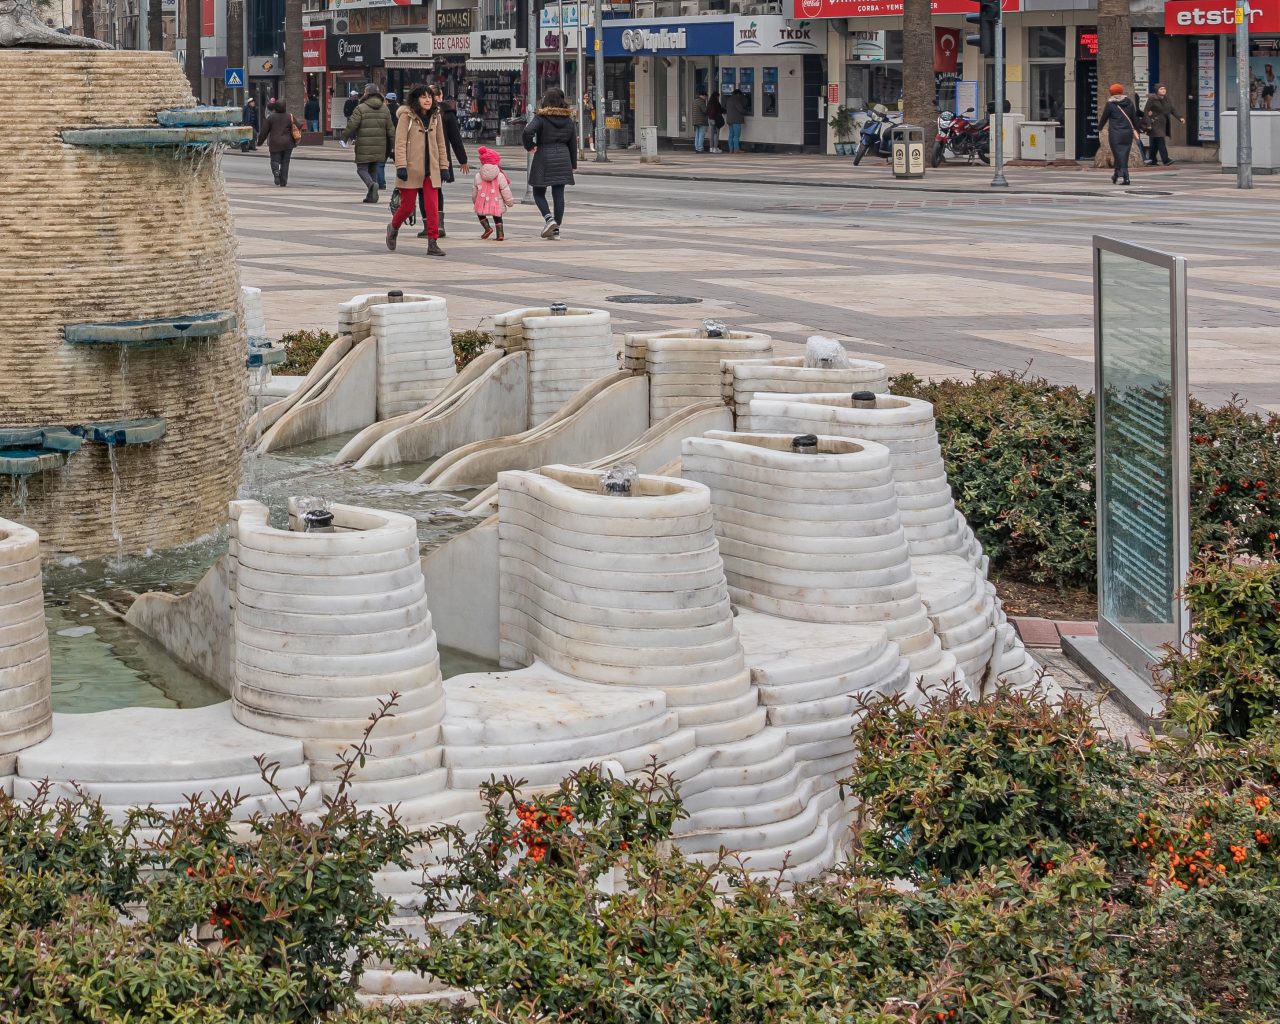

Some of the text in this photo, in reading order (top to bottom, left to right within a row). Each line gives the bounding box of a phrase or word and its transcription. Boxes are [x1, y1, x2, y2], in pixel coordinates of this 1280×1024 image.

[858, 5, 879, 13] ÇORBA
[437, 9, 470, 28] FARMASİ
[1177, 7, 1264, 26] etstr
[739, 29, 757, 39] TKDK
[779, 29, 811, 40] TKDK
[433, 38, 445, 50] EGE
